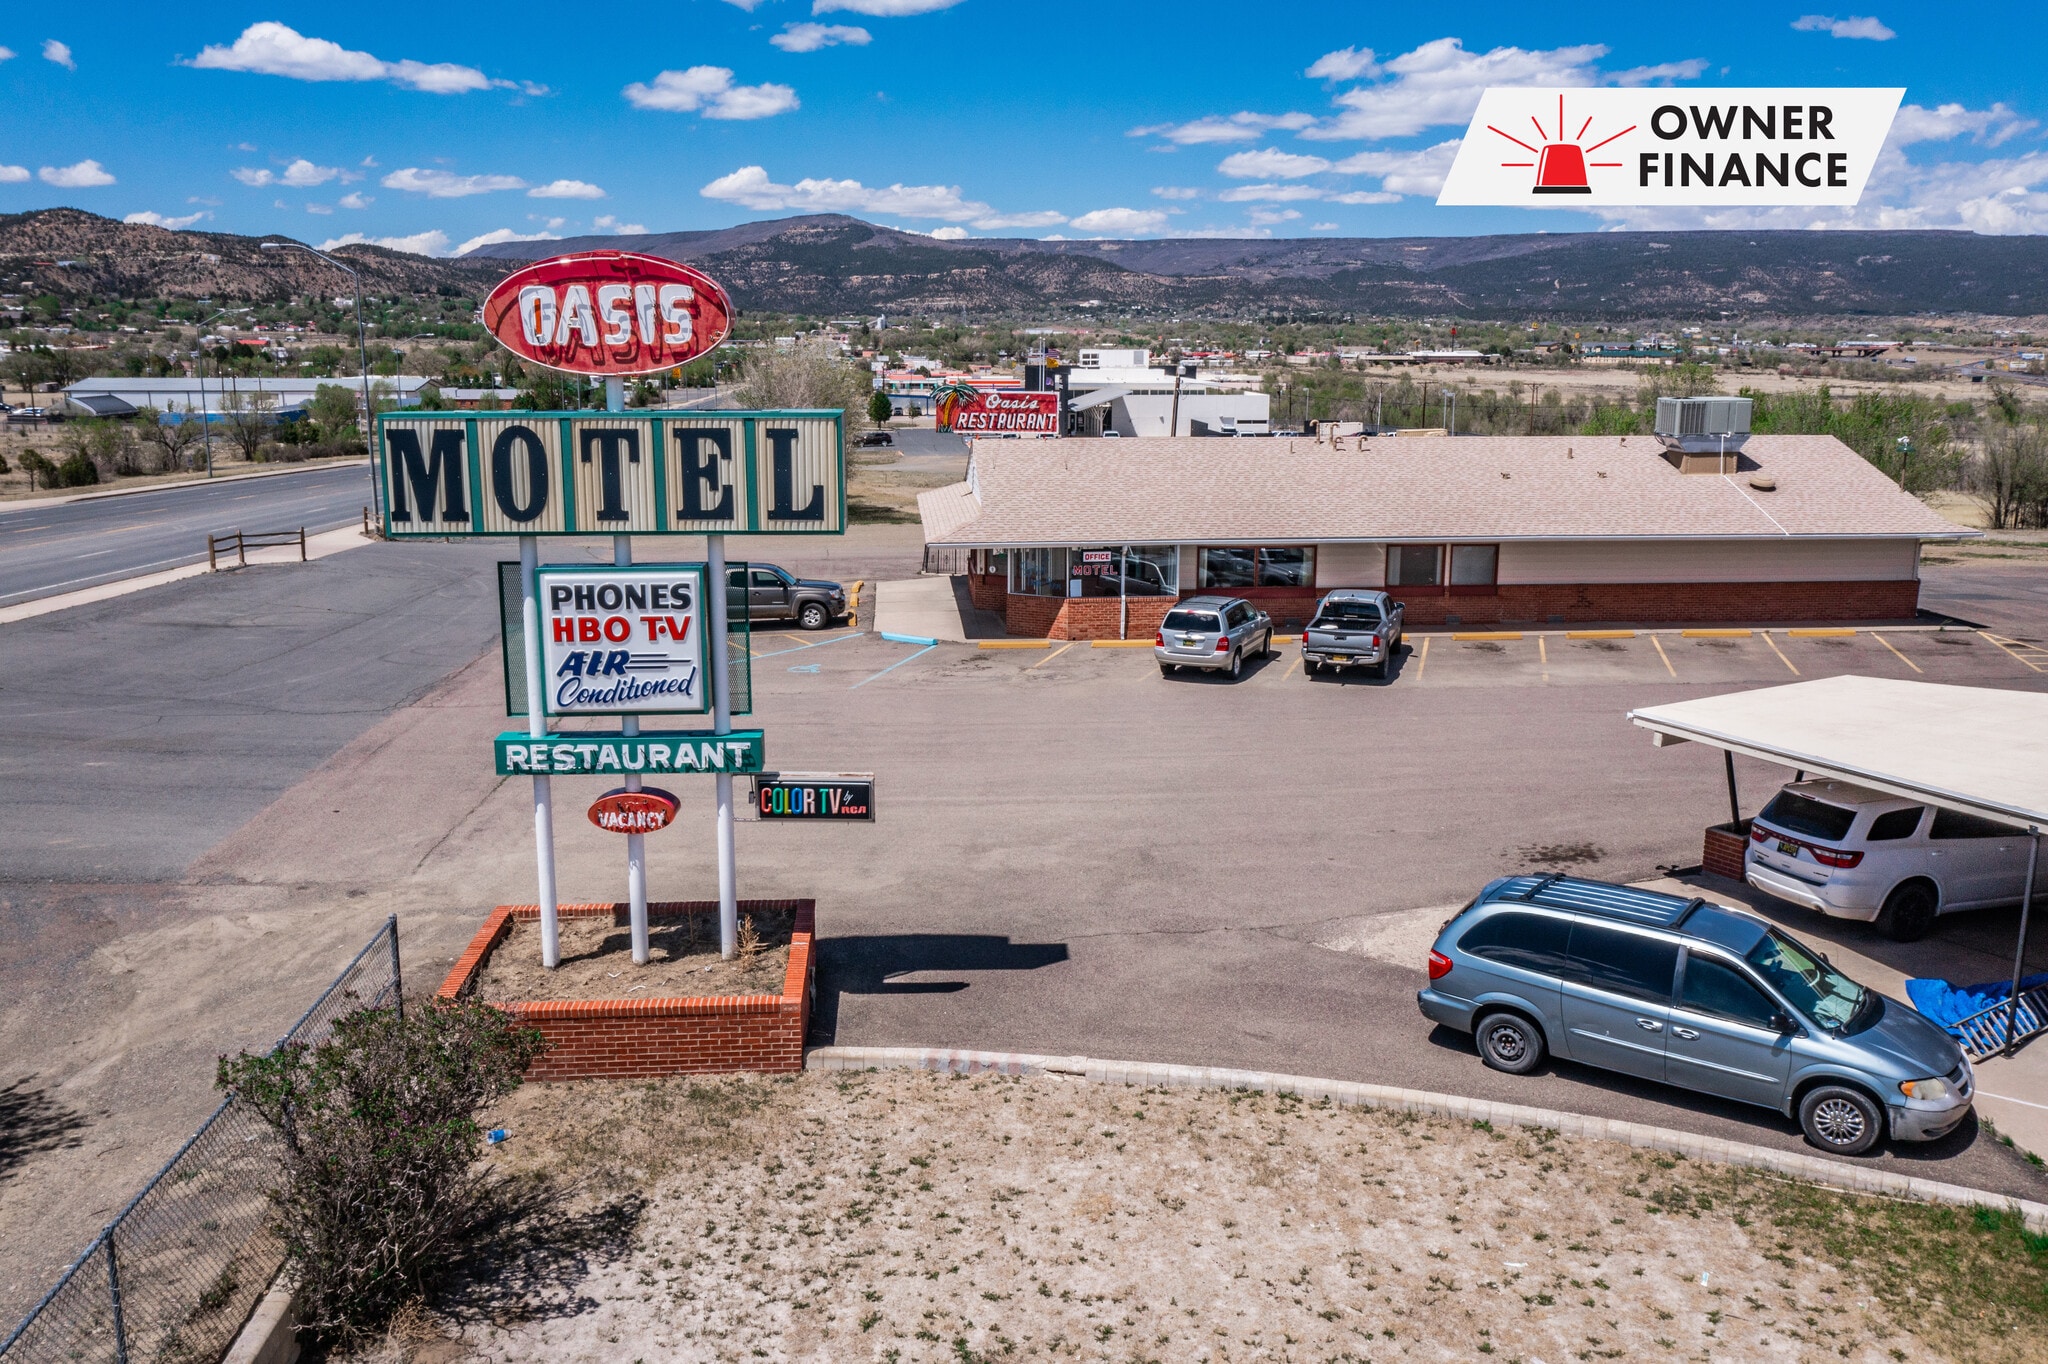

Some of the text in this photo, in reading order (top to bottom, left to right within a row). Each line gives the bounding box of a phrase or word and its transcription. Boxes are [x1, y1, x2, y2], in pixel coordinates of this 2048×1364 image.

[518, 284, 695, 347] OASIS
[985, 393, 1040, 409] Oasis
[956, 412, 1057, 430] RESTAURANT
[385, 425, 825, 523] MOTEL
[1073, 564, 1118, 576] MOTEL
[1084, 553, 1110, 561] OFFICE
[550, 583, 692, 611] PHONES
[552, 616, 631, 642] HBO
[556, 650, 630, 678] AIR
[556, 666, 697, 707] Conditioned
[506, 742, 751, 770] RESTAURANT
[761, 787, 854, 815] COLOR TV by
[841, 806, 867, 814] RCA
[599, 811, 665, 829] VACANCY
